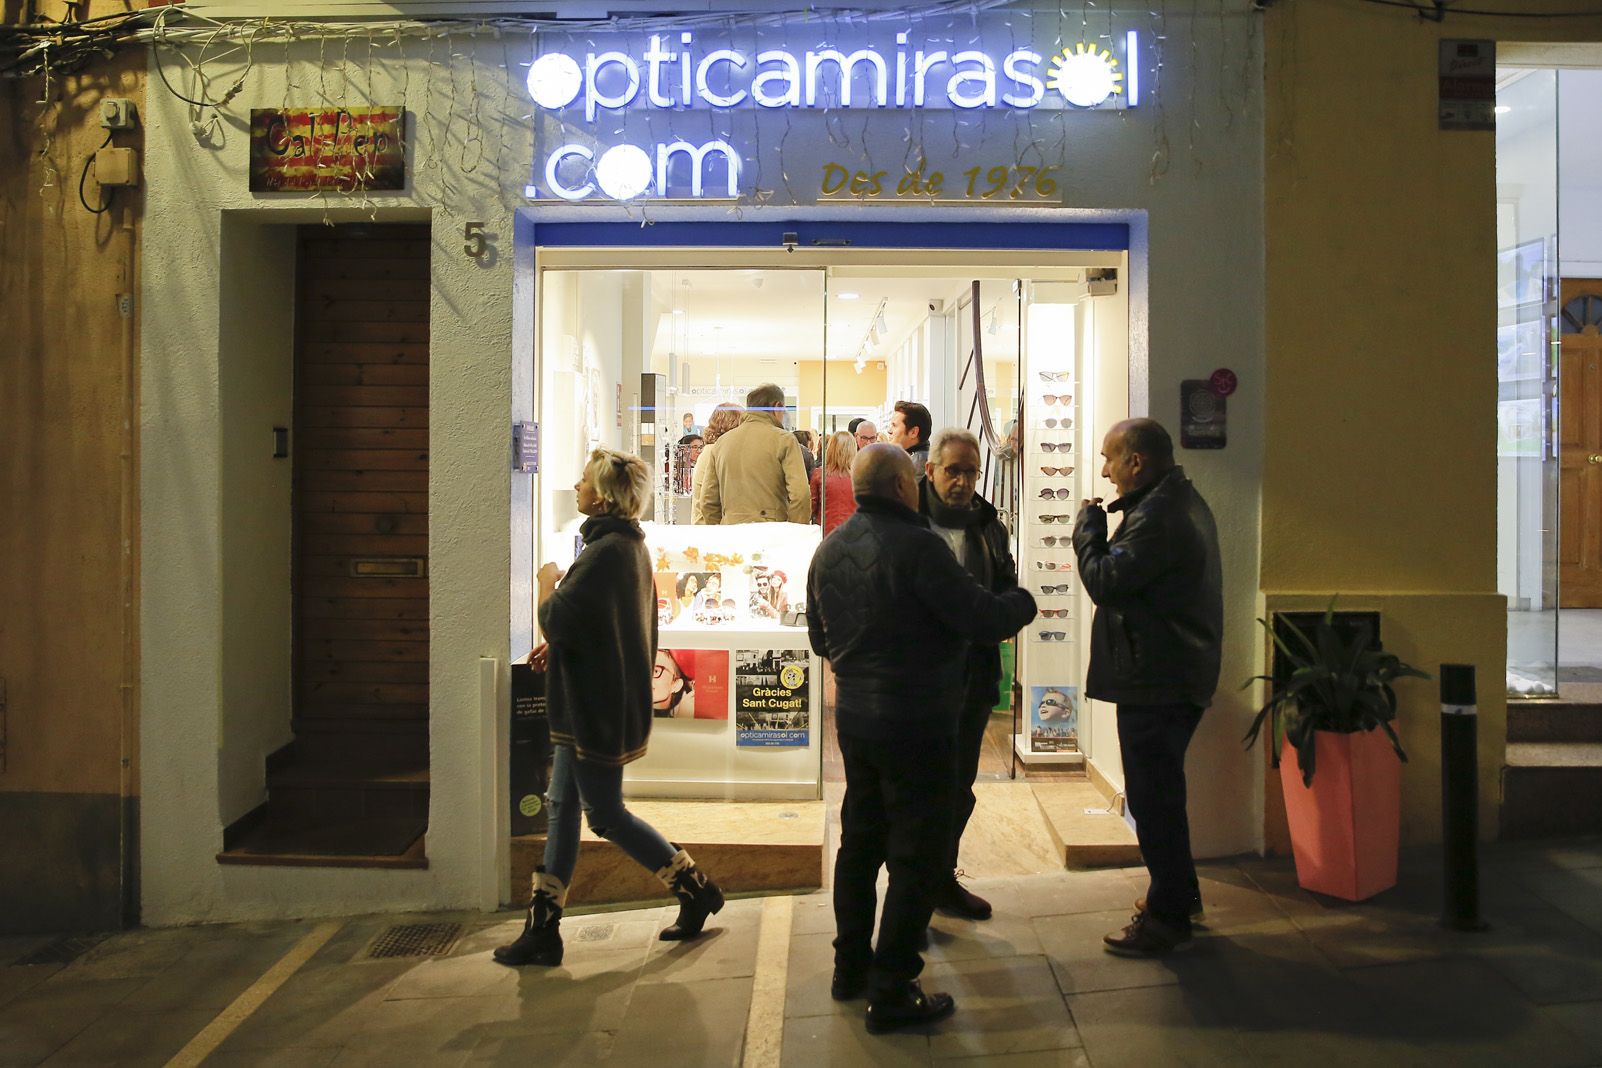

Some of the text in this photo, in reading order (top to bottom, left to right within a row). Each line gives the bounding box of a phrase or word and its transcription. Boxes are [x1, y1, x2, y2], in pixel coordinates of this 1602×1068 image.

[526, 31, 1139, 121] opticamirasol
[525, 139, 741, 200] .com
[821, 156, 1058, 200] Des de 1976
[464, 221, 486, 257] 5
[742, 698, 802, 709] Sant Cugat!
[752, 687, 792, 697] Gràcies
